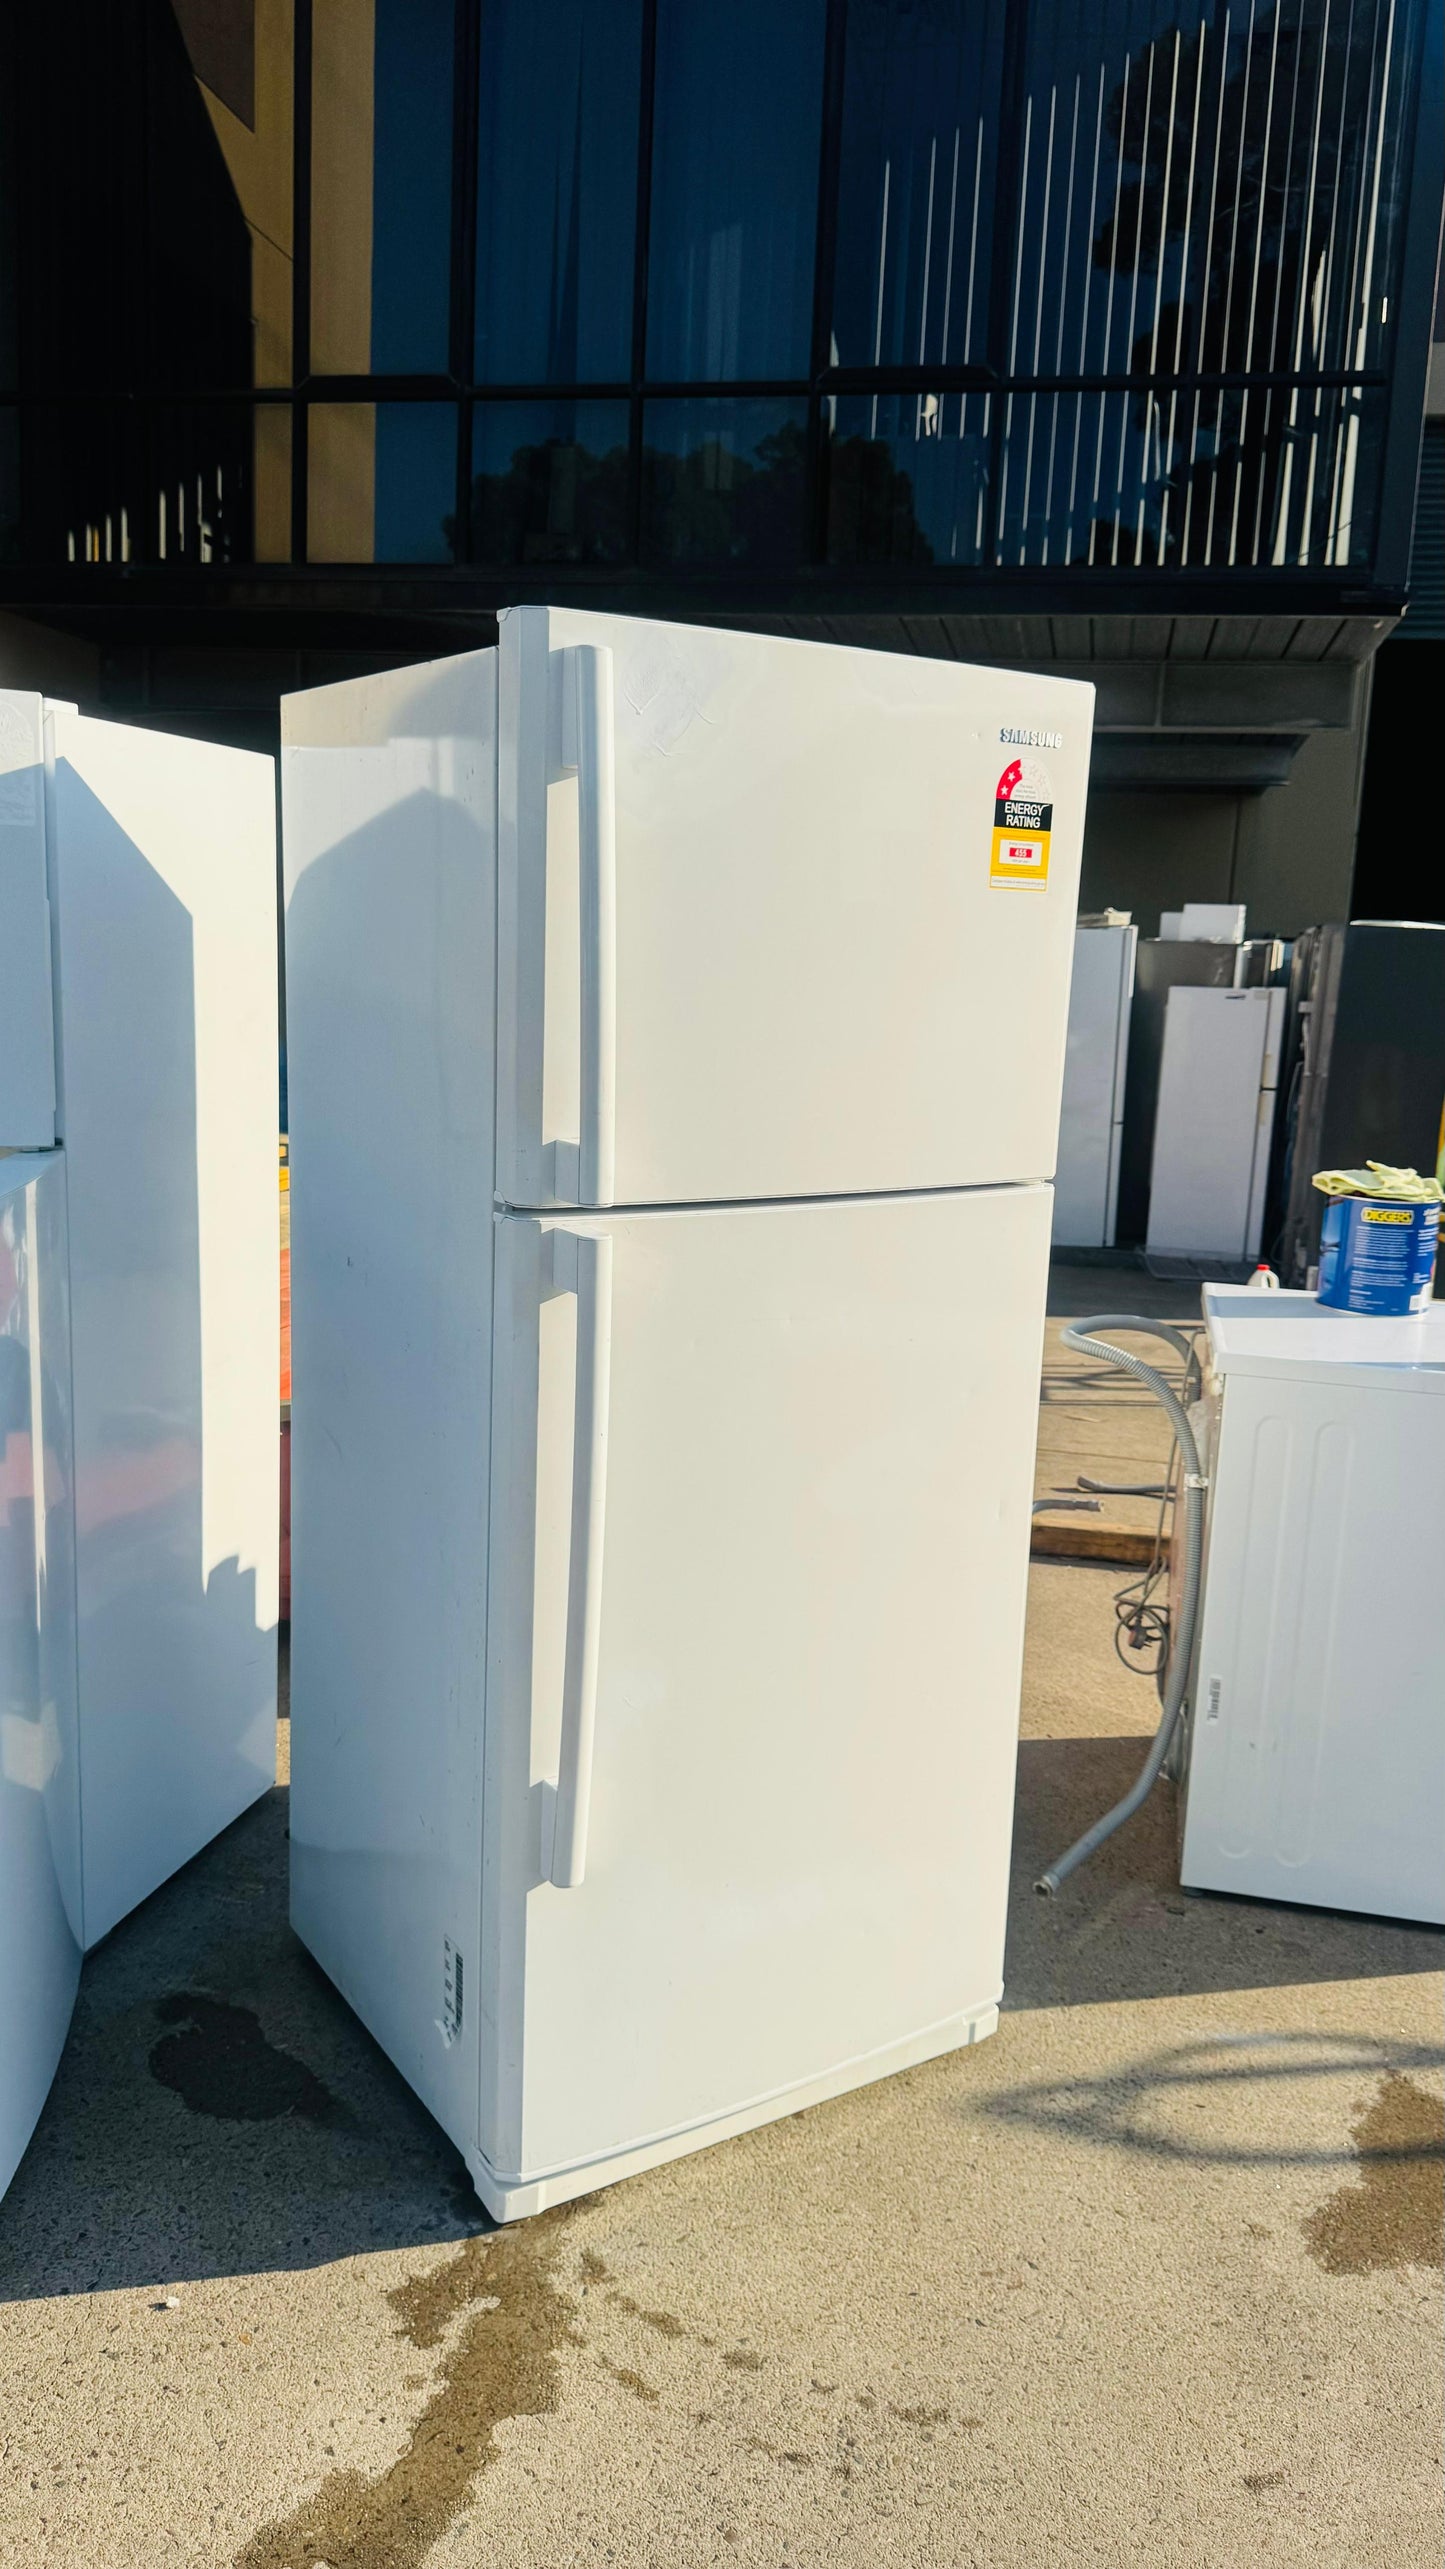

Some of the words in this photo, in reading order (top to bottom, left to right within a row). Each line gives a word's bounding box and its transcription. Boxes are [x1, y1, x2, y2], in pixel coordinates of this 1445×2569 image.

[1000, 728, 1062, 748] SAMSUNG
[1004, 801, 1045, 816] ENERGY
[1006, 815, 1041, 828] RATING
